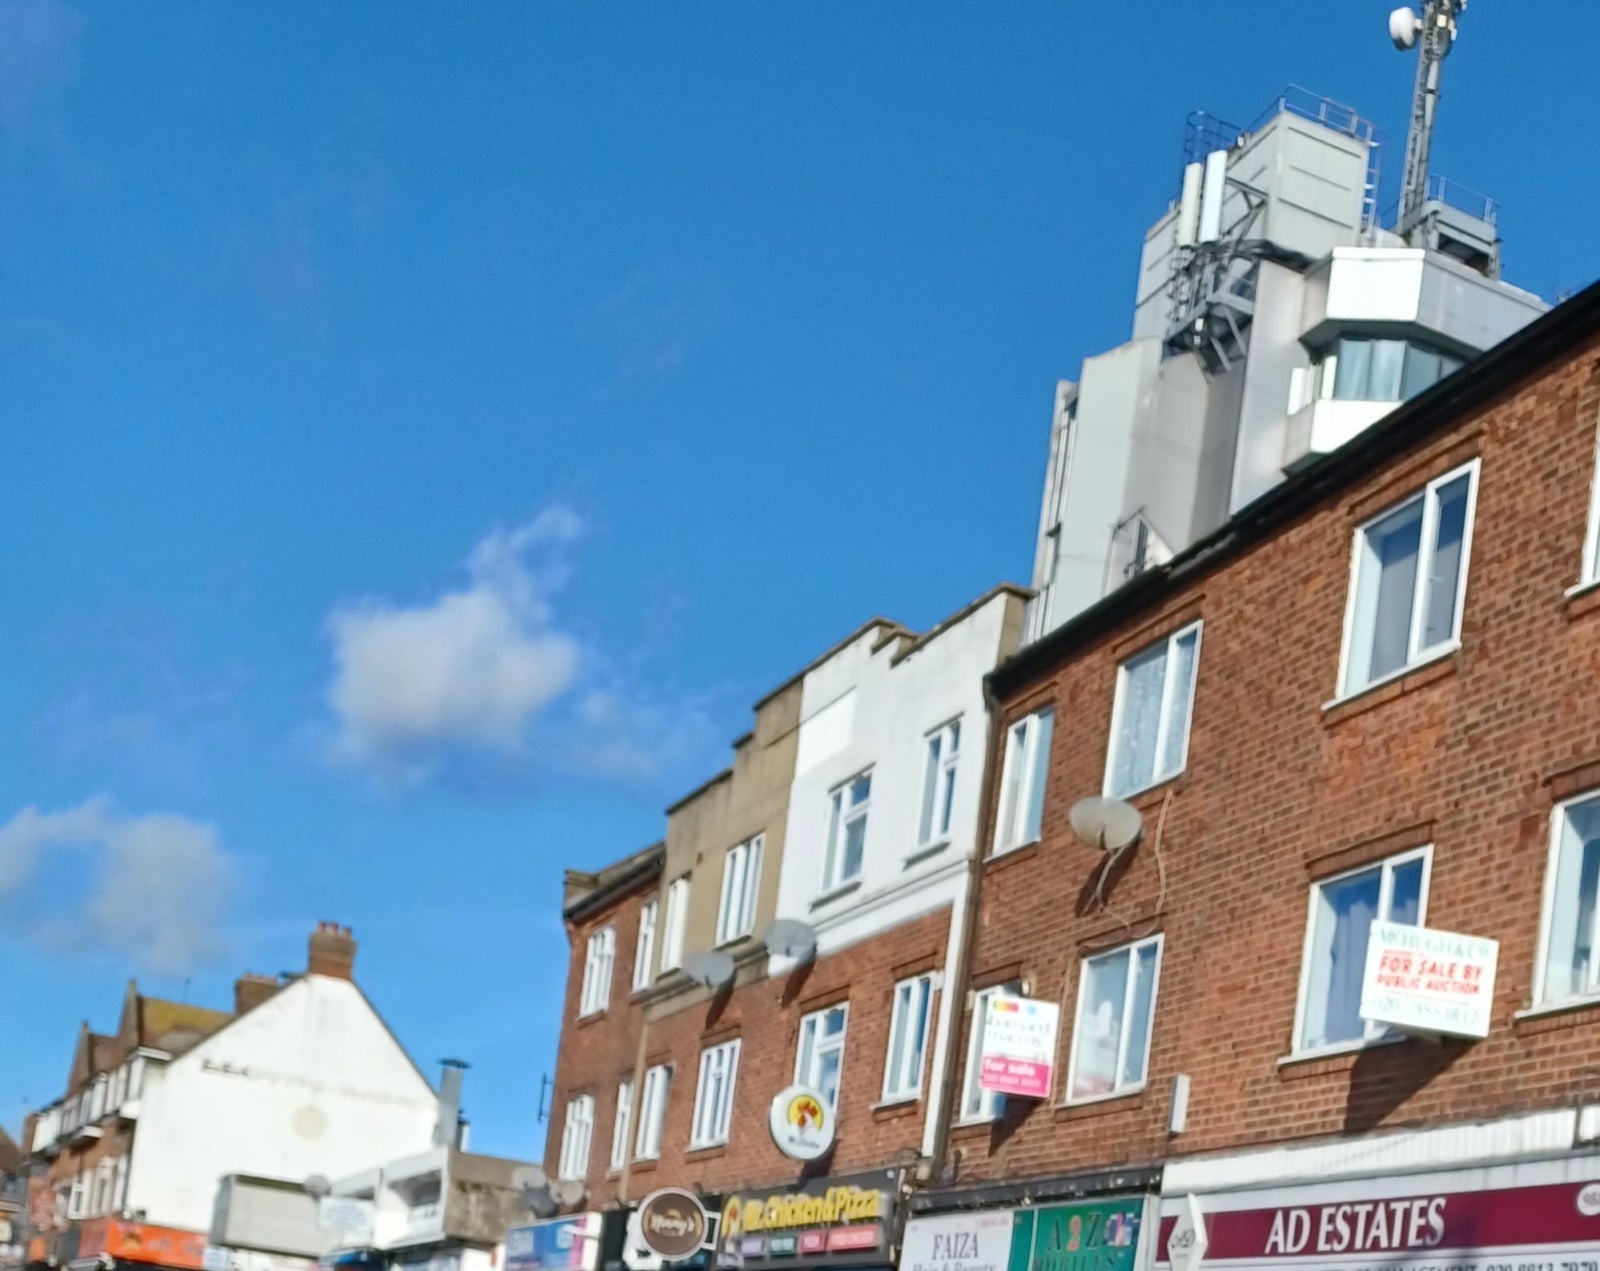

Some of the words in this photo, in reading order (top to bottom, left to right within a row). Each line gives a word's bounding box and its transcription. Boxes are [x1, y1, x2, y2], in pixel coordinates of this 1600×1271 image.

[1379, 956, 1412, 975] FOR
[1418, 959, 1458, 979] SALE
[1463, 964, 1483, 979] BY
[1376, 974, 1421, 990] PUBLIC
[1425, 979, 1480, 995] AUCTION
[1046, 1217, 1062, 1251] A
[1084, 1212, 1103, 1249] Z
[1264, 1208, 1311, 1255] AD
[1317, 1197, 1447, 1252] ESTATES
[931, 1231, 979, 1260] FAIZA
